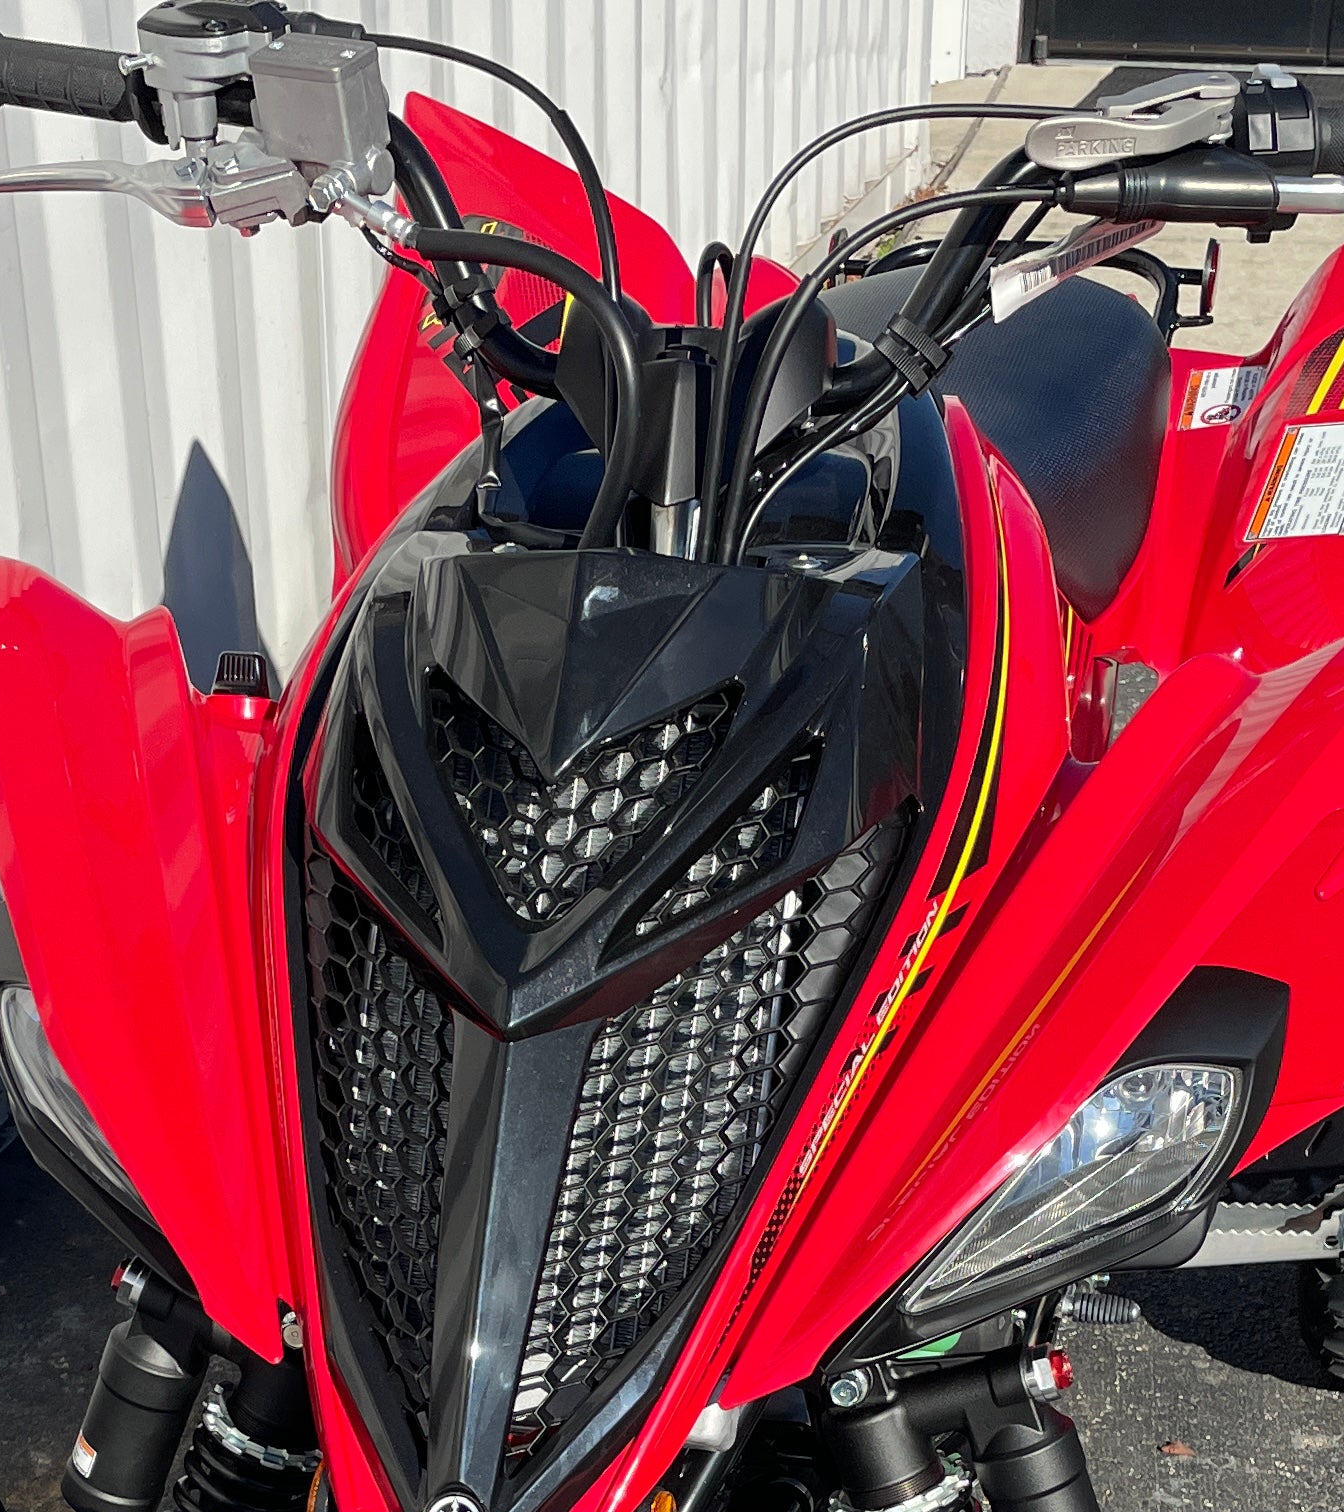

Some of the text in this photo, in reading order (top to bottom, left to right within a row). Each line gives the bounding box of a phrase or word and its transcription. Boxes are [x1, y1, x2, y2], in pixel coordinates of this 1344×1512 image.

[1056, 138, 1135, 156] PARKING
[799, 900, 939, 1177] SPECIAL EDITION
